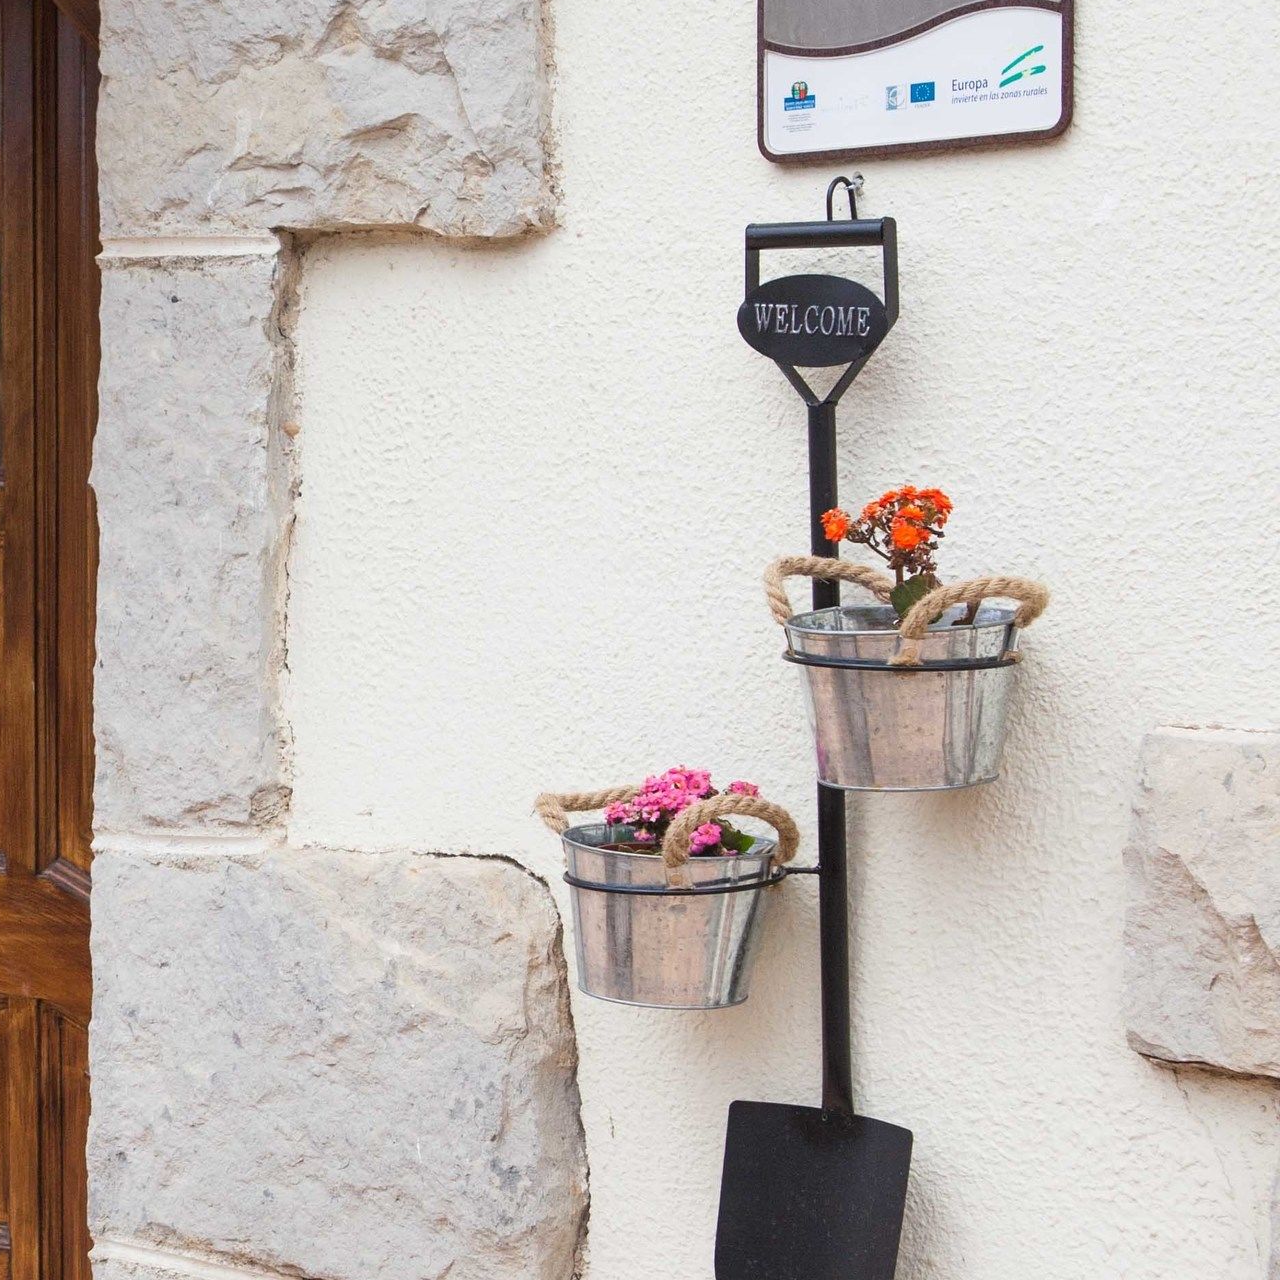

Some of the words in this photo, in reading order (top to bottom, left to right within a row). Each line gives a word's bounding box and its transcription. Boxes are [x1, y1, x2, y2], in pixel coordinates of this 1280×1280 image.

[951, 78, 989, 93] Europa
[951, 92, 978, 105] invierte
[979, 92, 988, 102] en
[989, 90, 1000, 101] las
[1001, 89, 1022, 99] zonas
[1023, 85, 1049, 97] rurales
[754, 303, 871, 337] WELCOME
